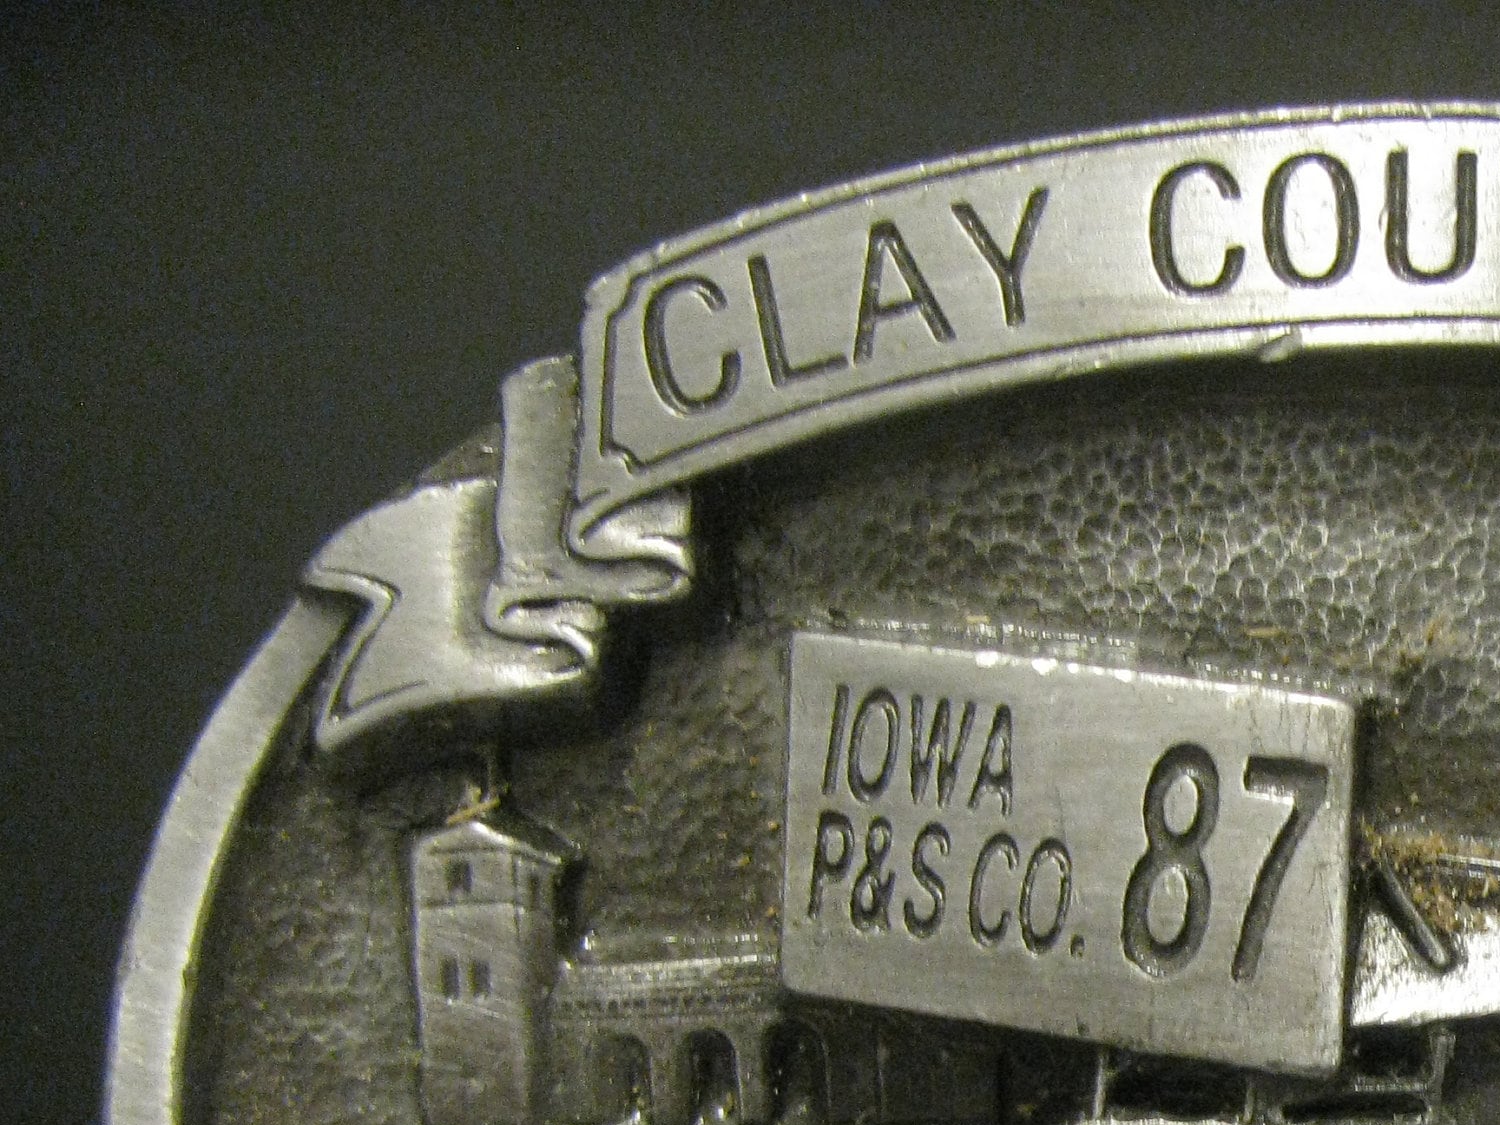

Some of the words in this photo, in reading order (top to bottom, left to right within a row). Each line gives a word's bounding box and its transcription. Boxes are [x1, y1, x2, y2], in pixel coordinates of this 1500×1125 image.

[642, 186, 1050, 416] CLAY
[821, 684, 1014, 818] IOWA
[1120, 741, 1330, 983] 87
